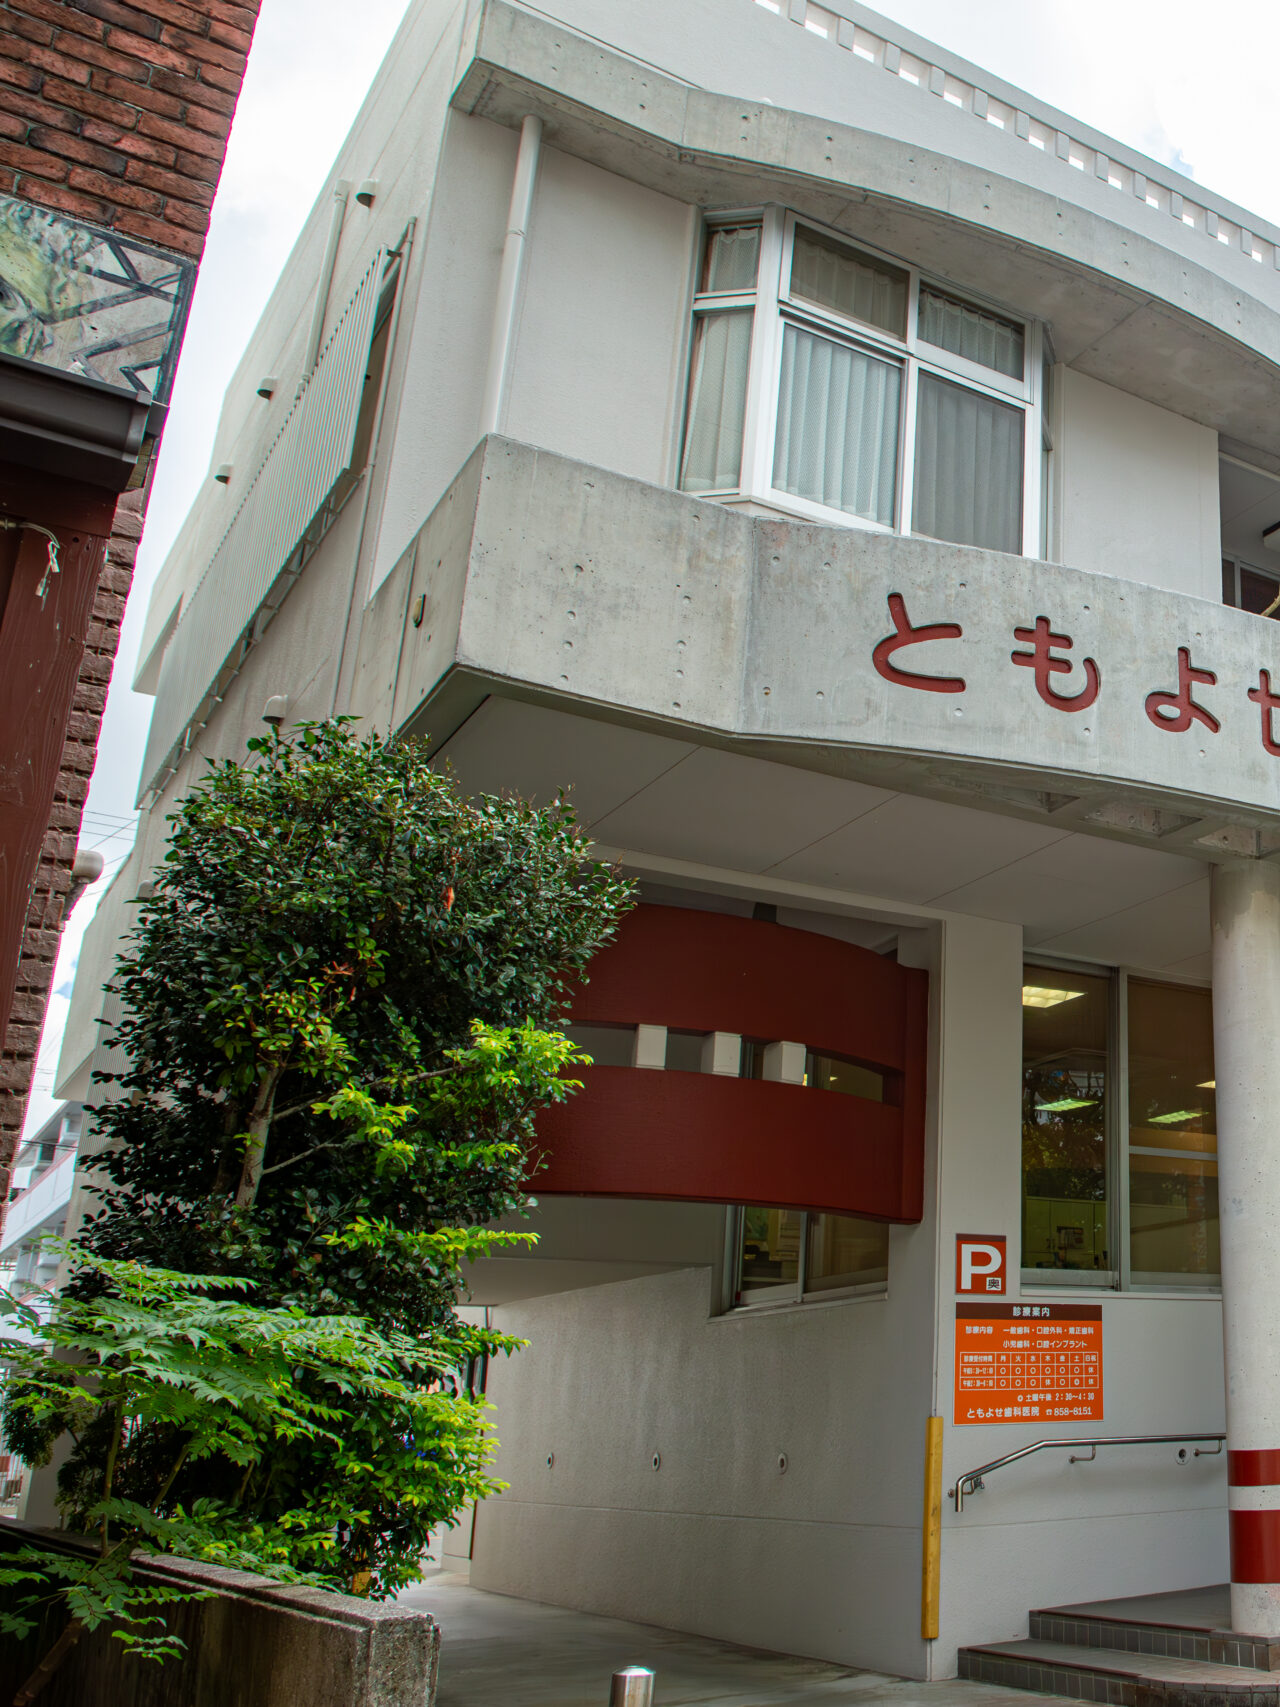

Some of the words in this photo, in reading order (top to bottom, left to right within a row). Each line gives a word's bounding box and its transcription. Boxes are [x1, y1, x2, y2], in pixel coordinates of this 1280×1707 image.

[961, 1244, 1002, 1289] P
[988, 1279, 1000, 1290] 奥
[1013, 1306, 1050, 1317] 診療案内
[965, 1326, 993, 1335] 診療内容
[967, 1406, 1039, 1418] ともよせ歯科医院
